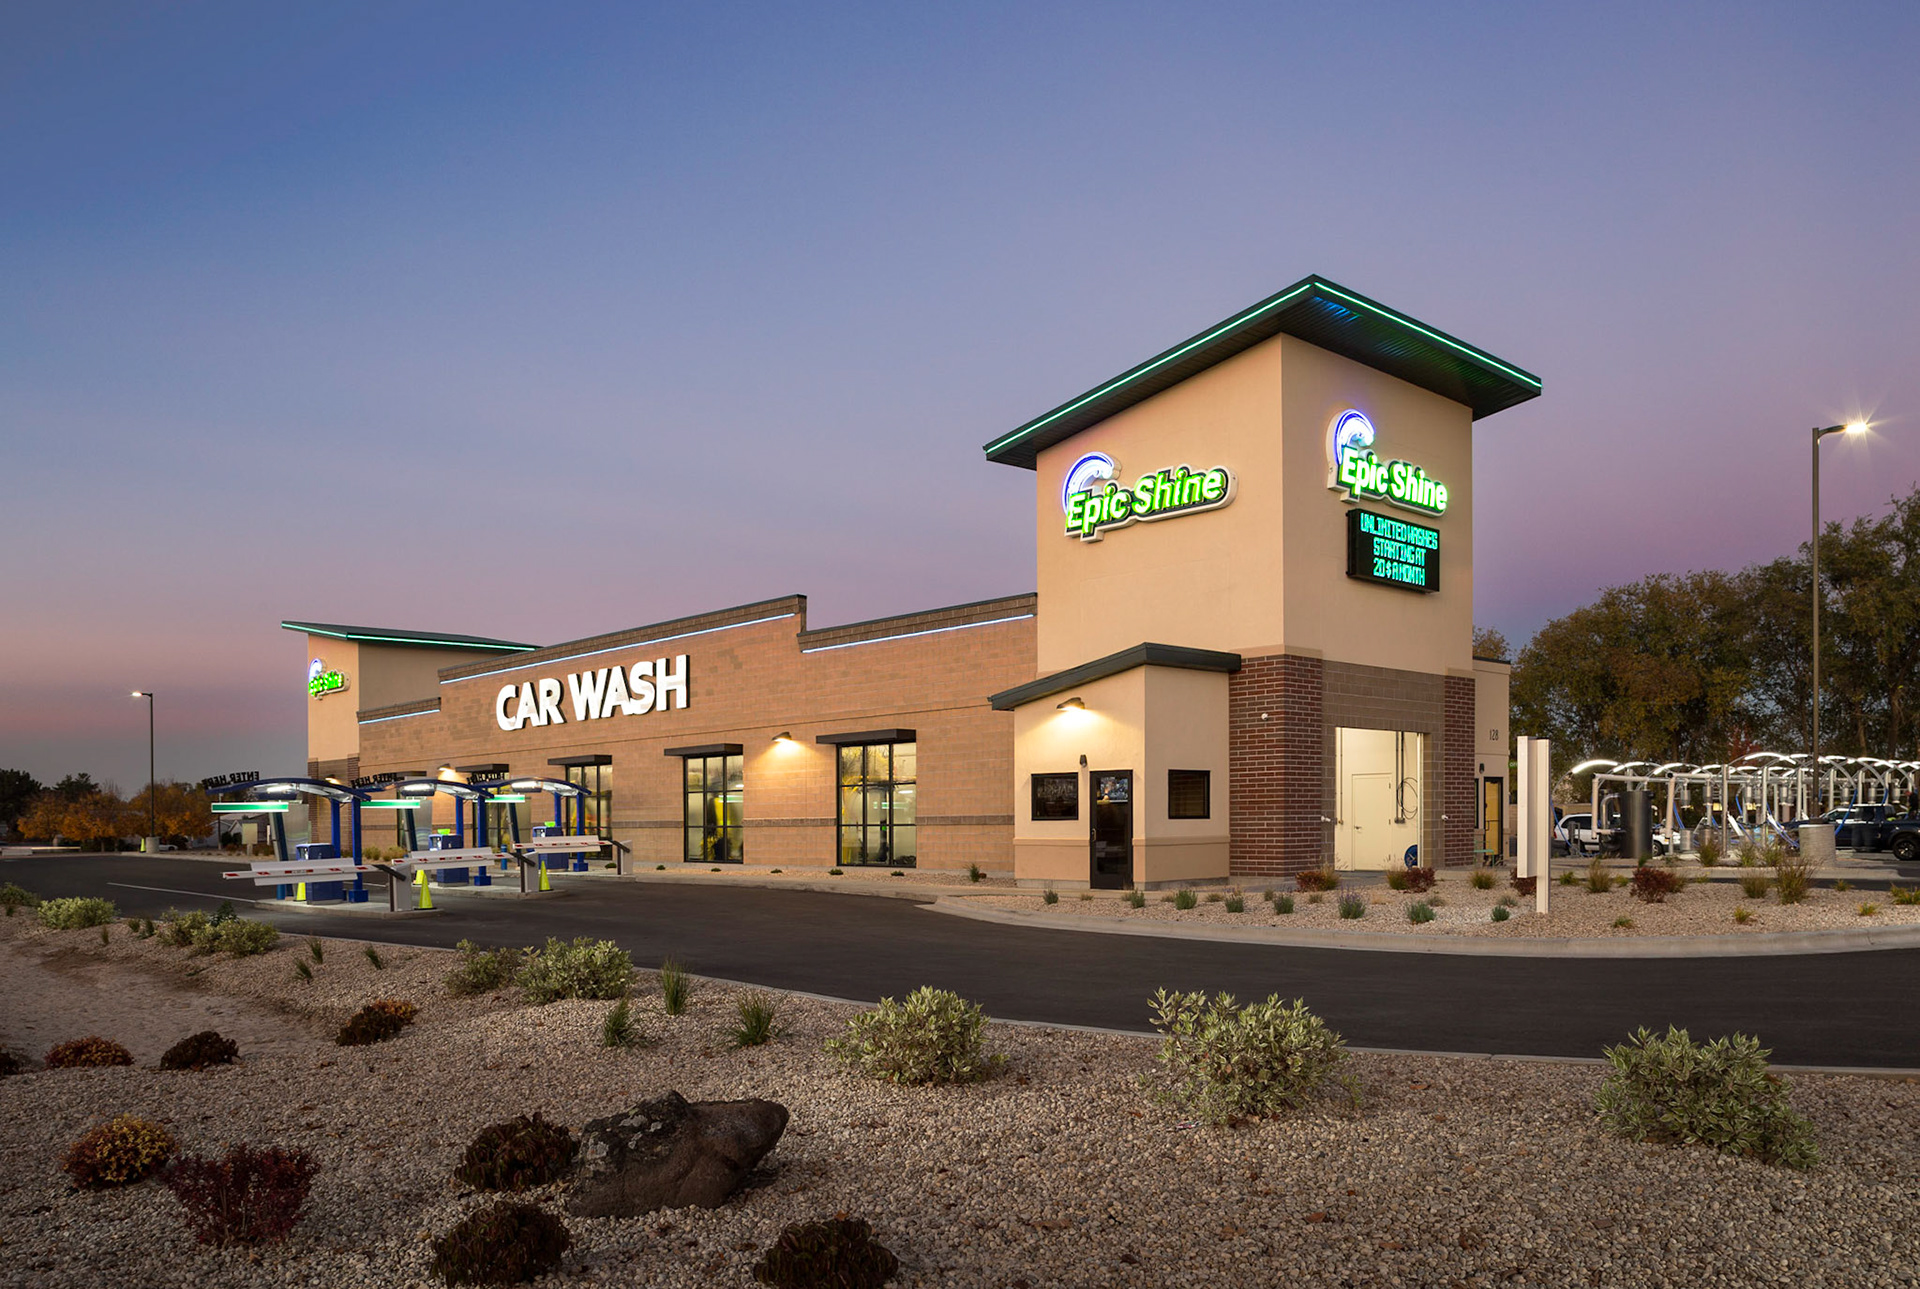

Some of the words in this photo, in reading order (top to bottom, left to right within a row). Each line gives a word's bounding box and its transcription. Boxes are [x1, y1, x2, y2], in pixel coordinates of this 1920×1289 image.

[1340, 446, 1388, 496] Epic
[1389, 463, 1448, 511] Shine
[1067, 484, 1129, 534] Epic
[1131, 468, 1223, 514] Shine
[1360, 513, 1407, 542] UNLIMITED
[1407, 525, 1438, 550] WASHES
[1373, 537, 1415, 563] STARTING
[1415, 547, 1427, 566] AT
[1399, 564, 1426, 586] MONTH
[495, 677, 566, 732] CAR
[567, 654, 690, 721] WASH
[1489, 728, 1499, 741] 128
